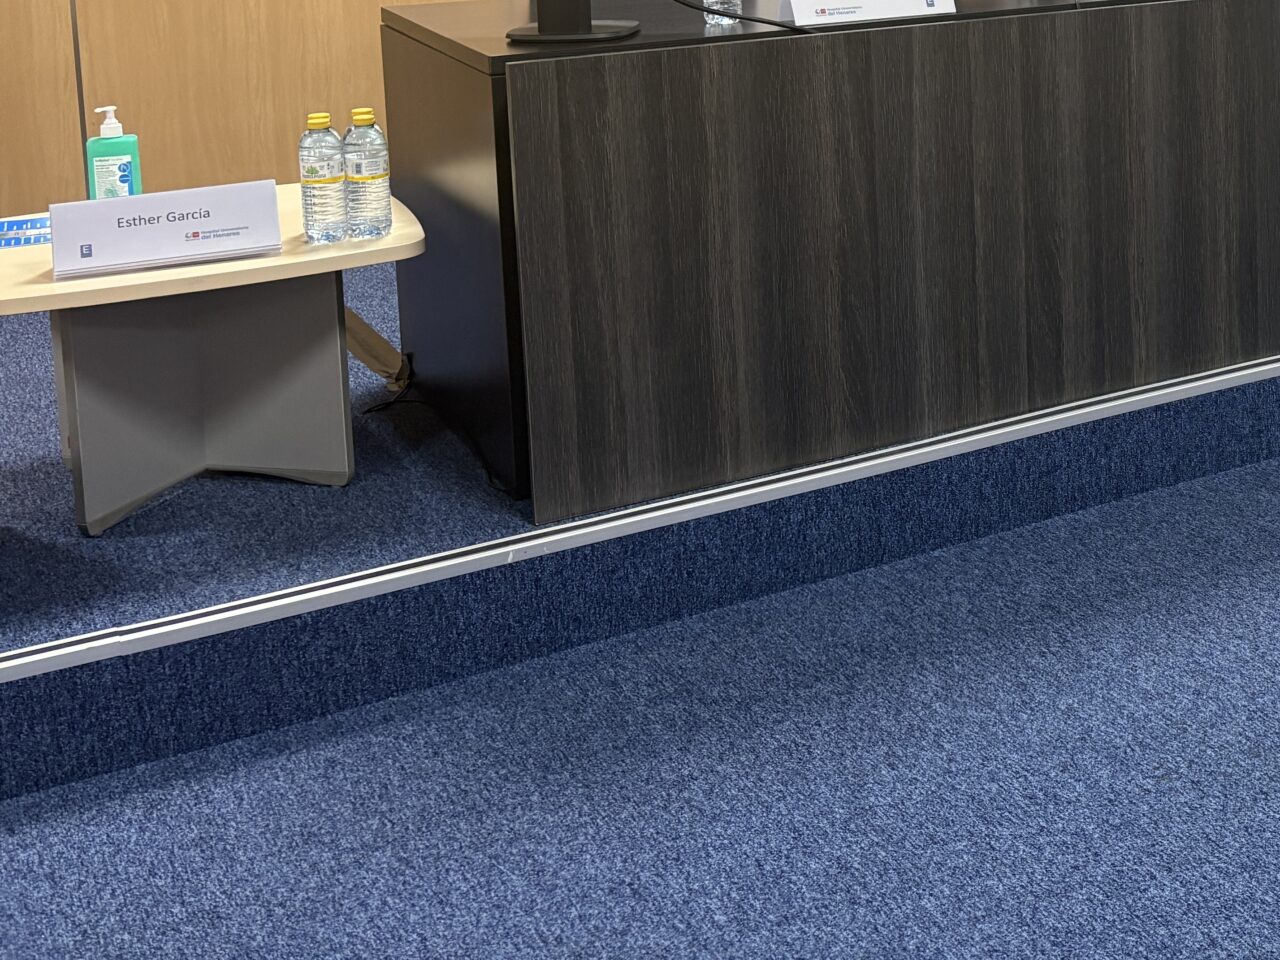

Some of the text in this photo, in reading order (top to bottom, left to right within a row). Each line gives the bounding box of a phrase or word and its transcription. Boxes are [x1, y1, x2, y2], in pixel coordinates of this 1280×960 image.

[117, 208, 211, 228] Esther García
[82, 245, 91, 254] E
